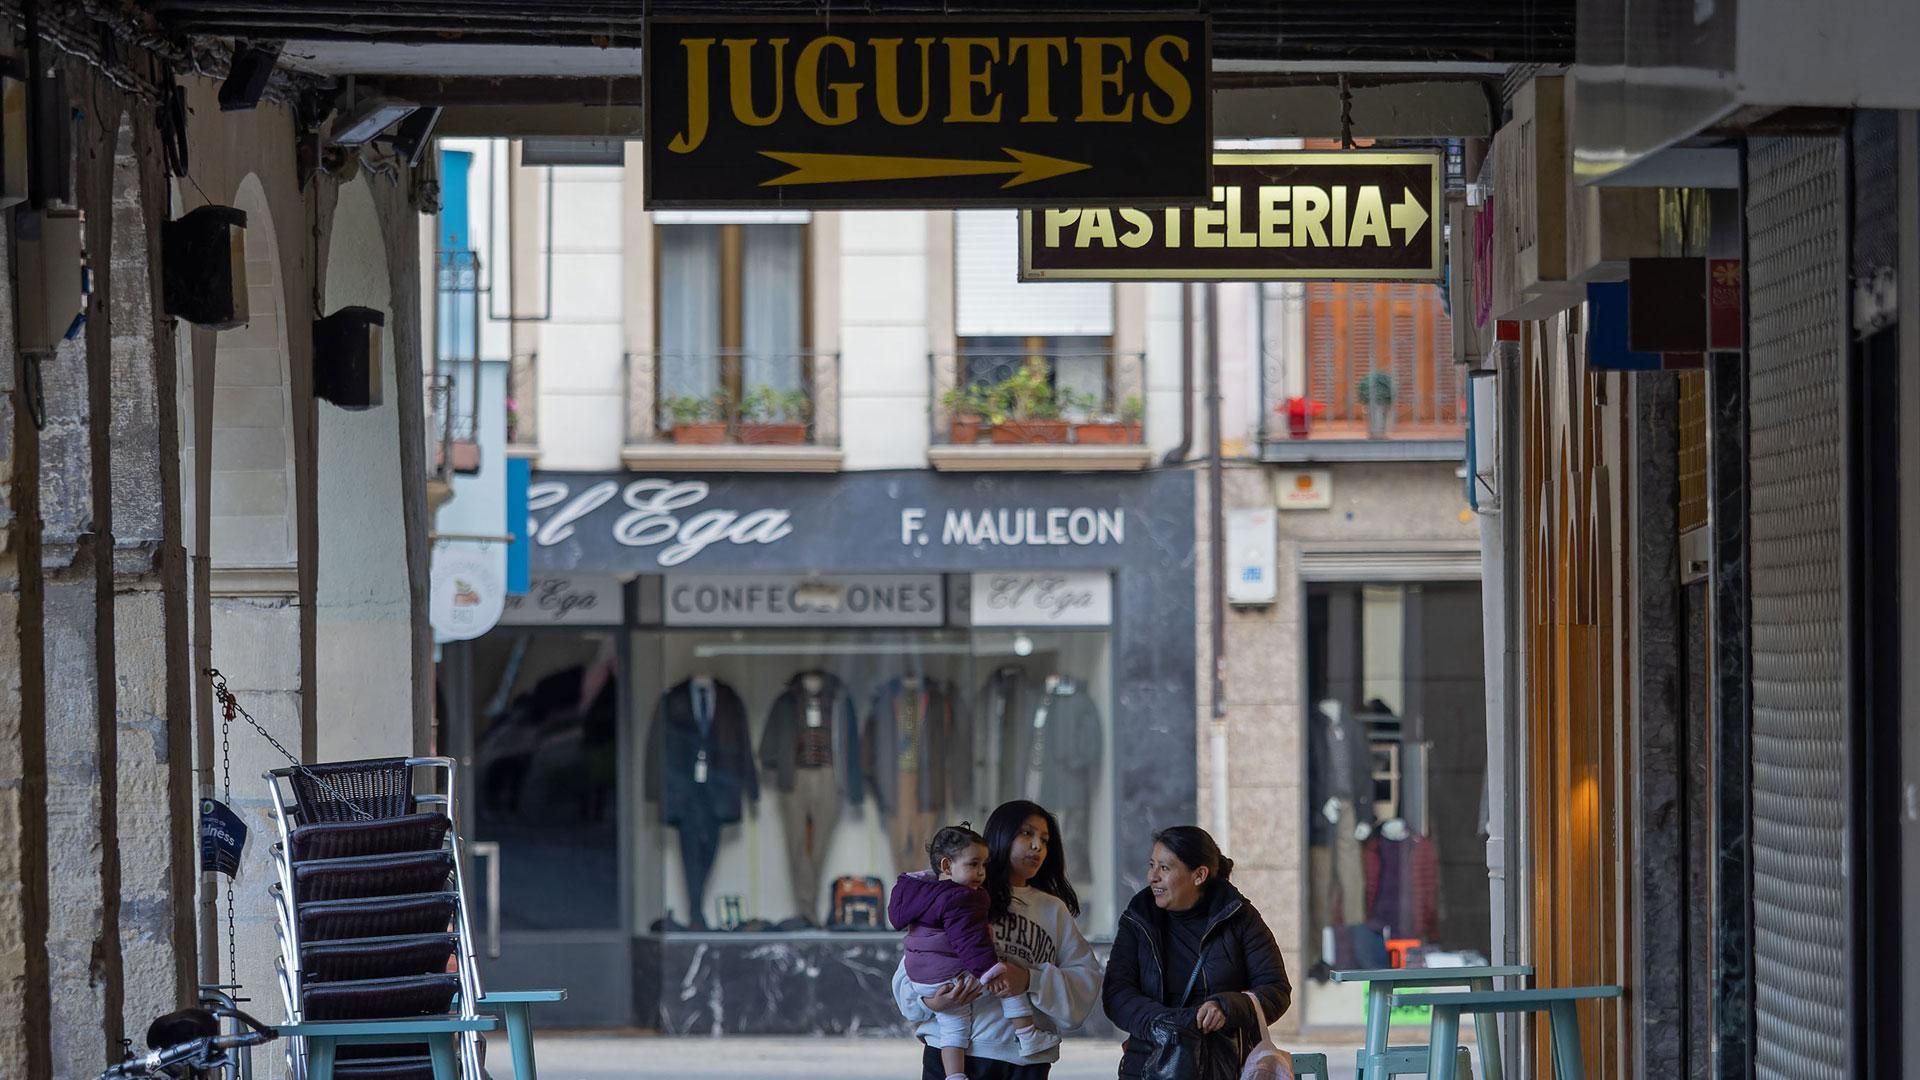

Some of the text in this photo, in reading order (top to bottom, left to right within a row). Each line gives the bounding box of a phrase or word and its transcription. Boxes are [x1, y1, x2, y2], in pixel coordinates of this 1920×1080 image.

[667, 35, 1192, 154] JUGUETES
[612, 478, 793, 566] Ega
[901, 507, 1126, 546] F. MAULEON
[671, 583, 937, 614] CONFECONES
